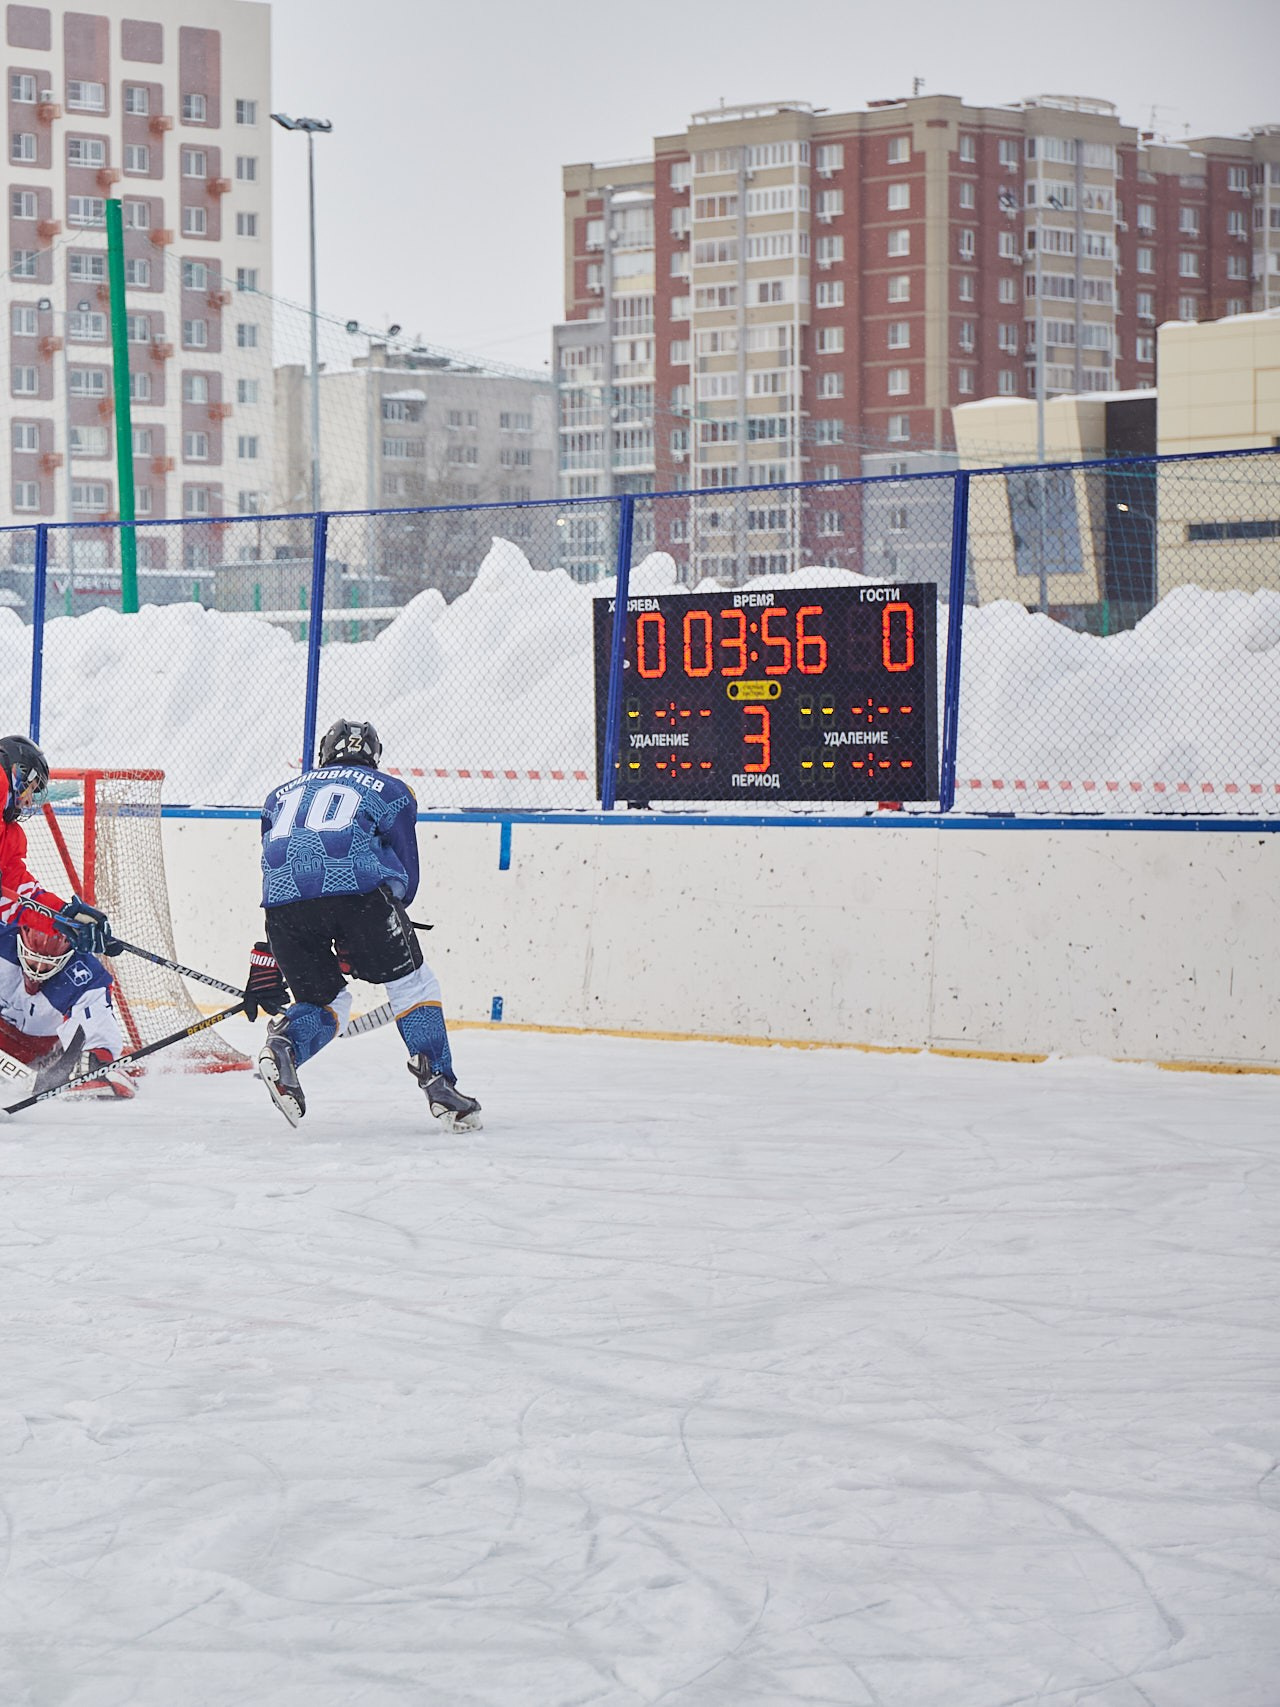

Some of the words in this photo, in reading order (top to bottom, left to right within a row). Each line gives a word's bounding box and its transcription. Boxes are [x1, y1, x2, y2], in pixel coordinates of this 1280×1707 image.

[733, 594, 774, 607] ВРЕМЯ
[860, 588, 900, 602] ГОСТИ
[608, 599, 660, 612] ХЯЕВА
[683, 606, 827, 677] 03:56
[882, 602, 914, 672] 0
[637, 612, 666, 678] 0
[629, 733, 689, 748] УДАЛЕНИЕ
[743, 705, 770, 773] 3
[824, 731, 888, 746] УДАЛЕНИЕ
[732, 774, 780, 789] ПЕРИОД
[270, 783, 362, 842] 10
